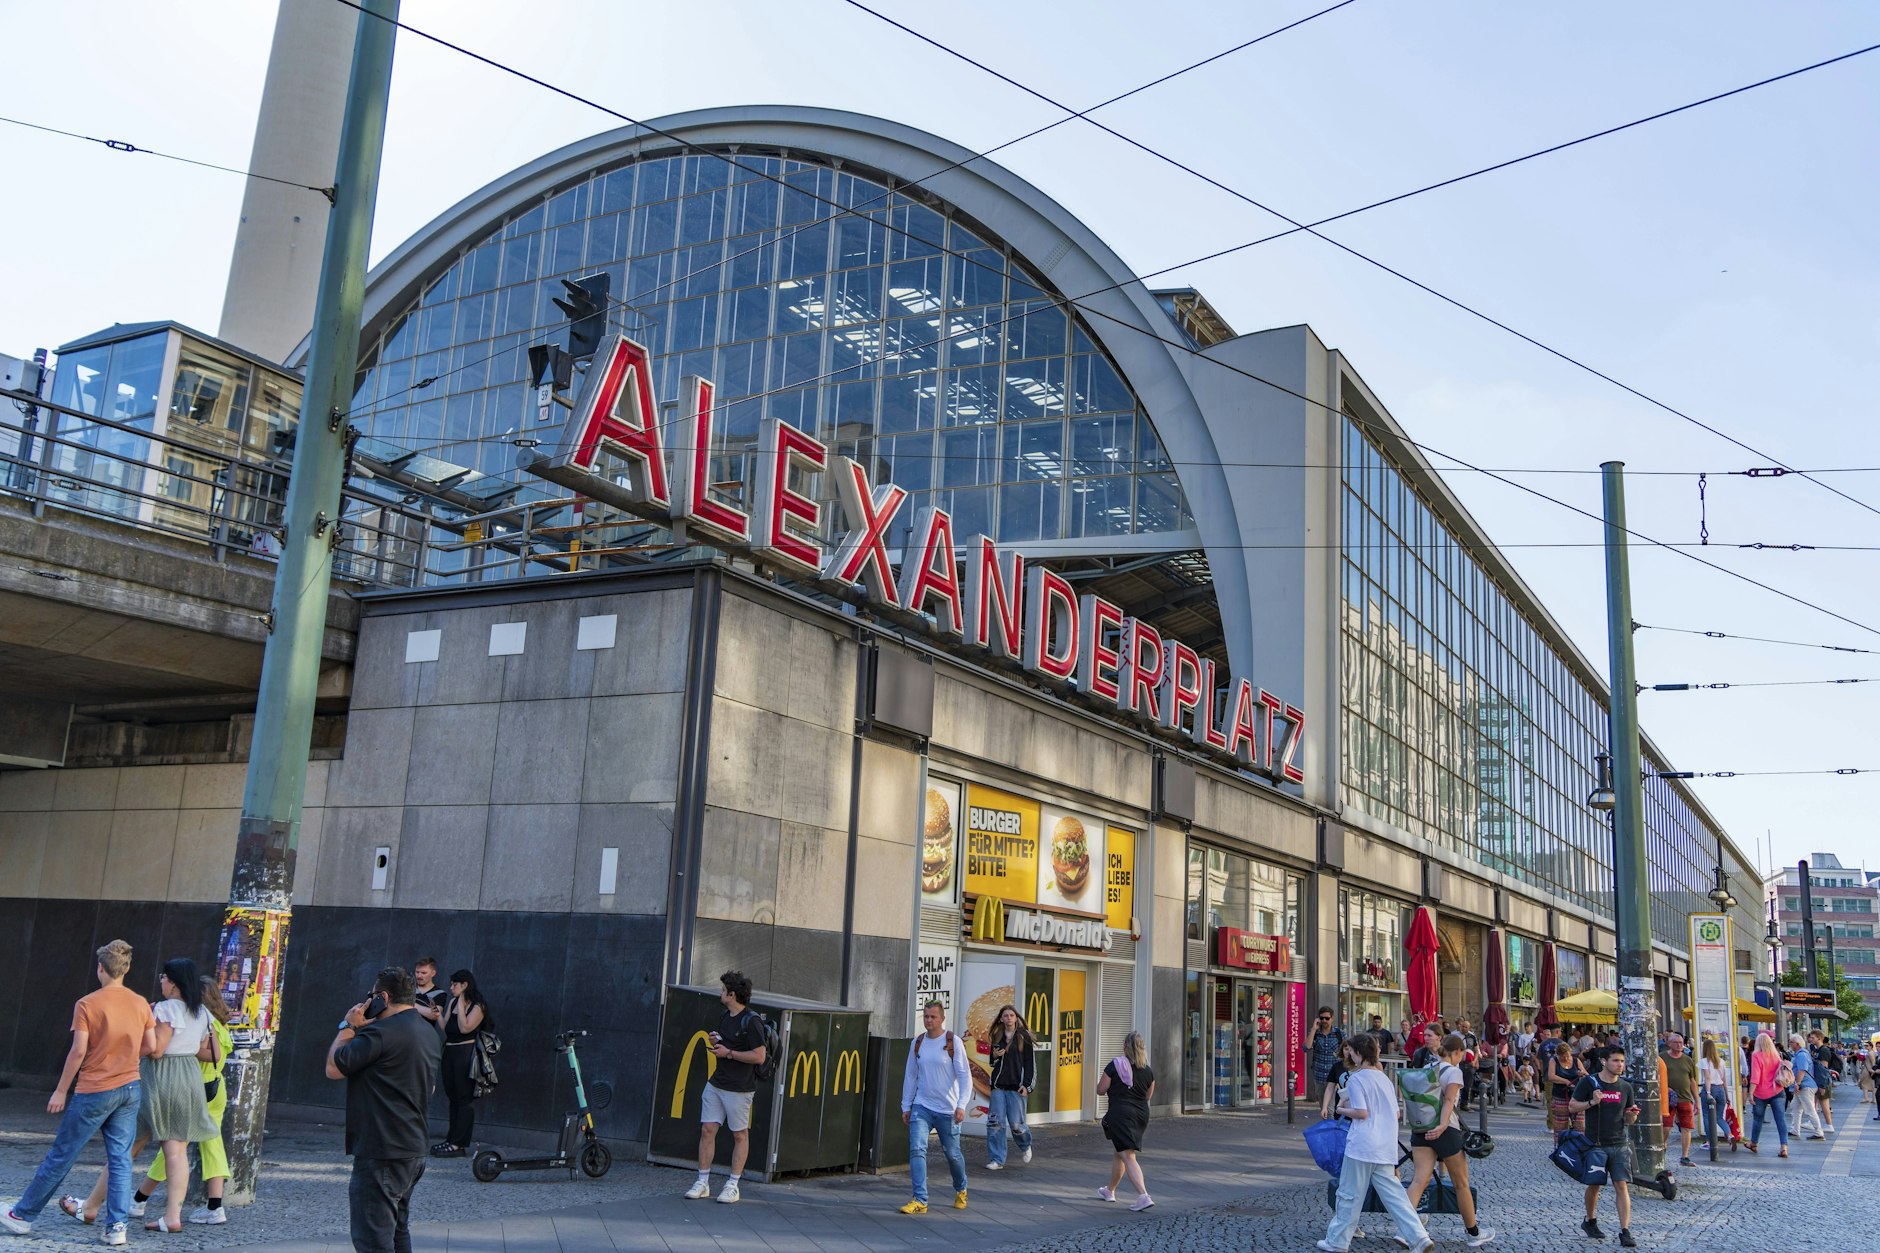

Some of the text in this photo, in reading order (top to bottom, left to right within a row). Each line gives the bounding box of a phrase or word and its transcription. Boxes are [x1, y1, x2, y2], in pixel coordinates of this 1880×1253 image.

[552, 333, 1306, 785] ALEXANDERPLATZ
[969, 807, 1021, 835] BURGER
[994, 835, 1035, 859] MITTE?
[968, 854, 1007, 878] BITTE!
[1108, 853, 1122, 869] ICH
[1107, 870, 1131, 886] LIEBE
[1107, 887, 1121, 903] ES!
[1006, 908, 1113, 951] McDonald's
[1242, 934, 1277, 953] CURRYWURST
[1249, 952, 1270, 966] EXPRESS
[931, 974, 942, 990] IN
[1059, 1055, 1073, 1067] DICH
